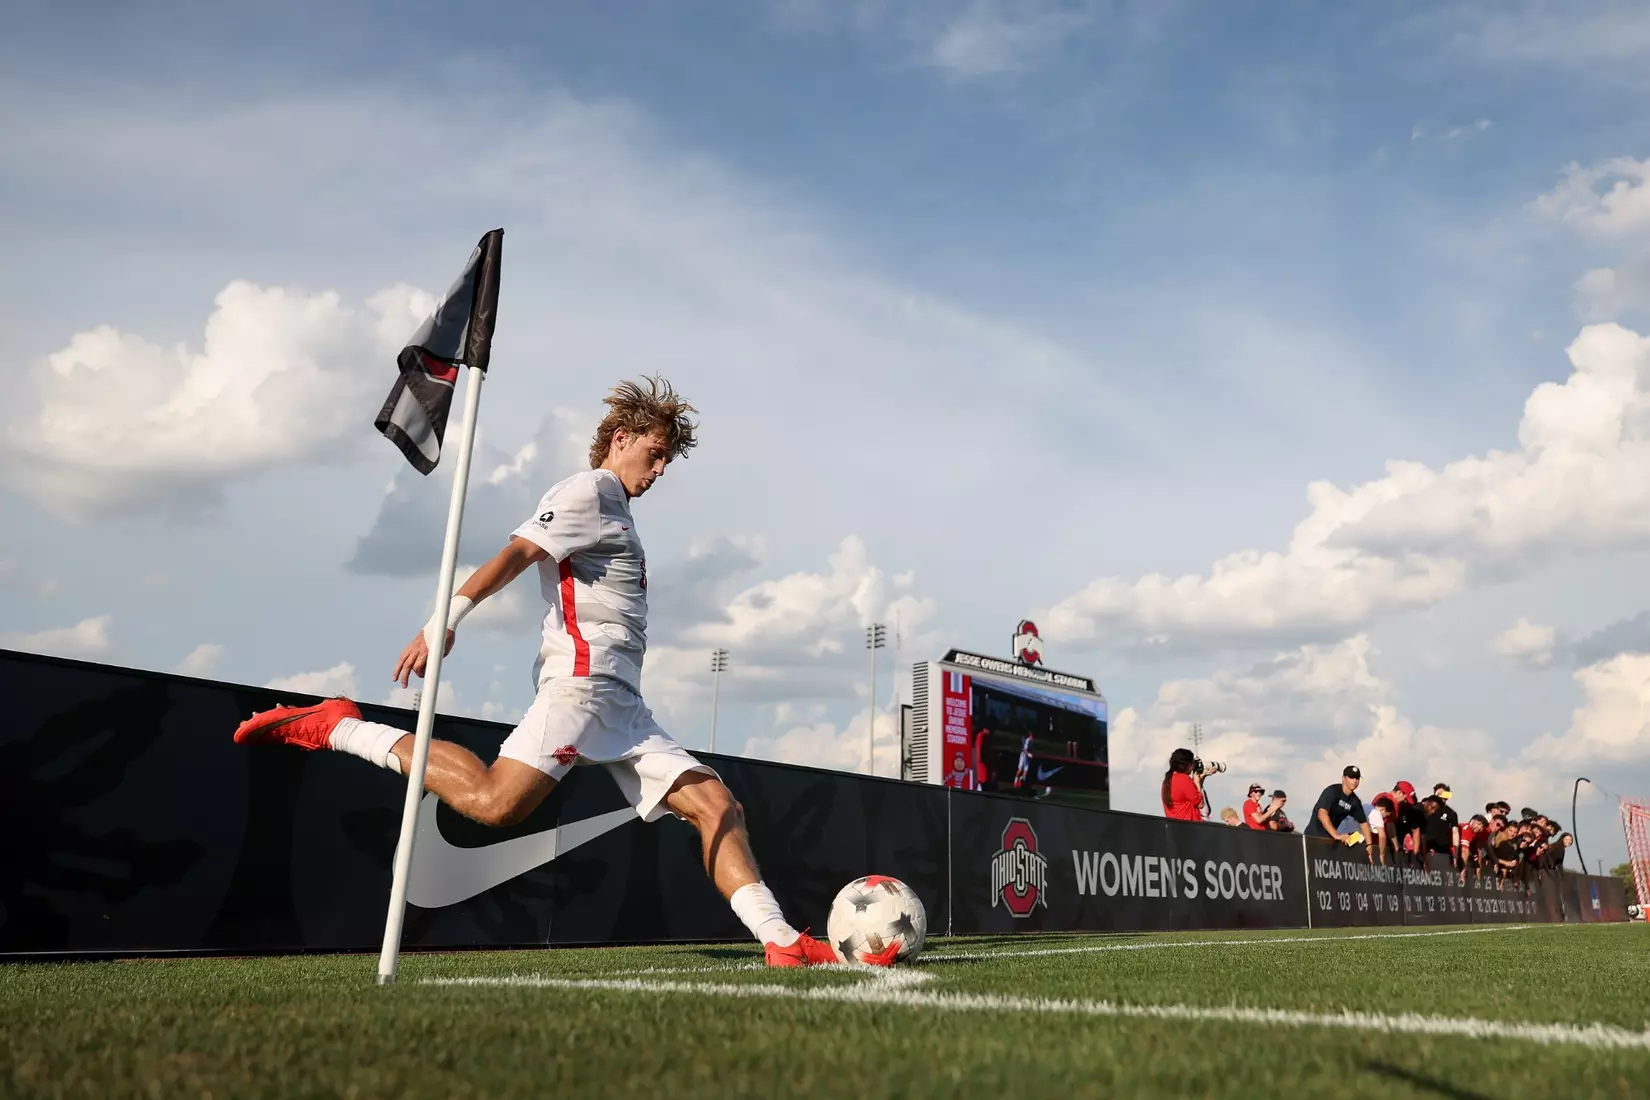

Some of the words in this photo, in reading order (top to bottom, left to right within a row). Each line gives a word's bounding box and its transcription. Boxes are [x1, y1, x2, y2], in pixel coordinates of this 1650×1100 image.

[954, 653, 981, 668] JESSE
[981, 658, 1013, 674] OWENS
[1054, 674, 1088, 690] STADIUM
[1072, 849, 1199, 900] WOMEN'S
[1204, 859, 1285, 901] SOCCER
[1314, 858, 1342, 879] NCAA
[1342, 861, 1395, 883] TOURNAMENT
[1396, 867, 1443, 887] APEARANCES
[1316, 890, 1332, 911] '02
[1337, 891, 1351, 911] '03
[1355, 892, 1369, 912] '04
[1372, 893, 1383, 912] '07
[1387, 894, 1399, 912] '09
